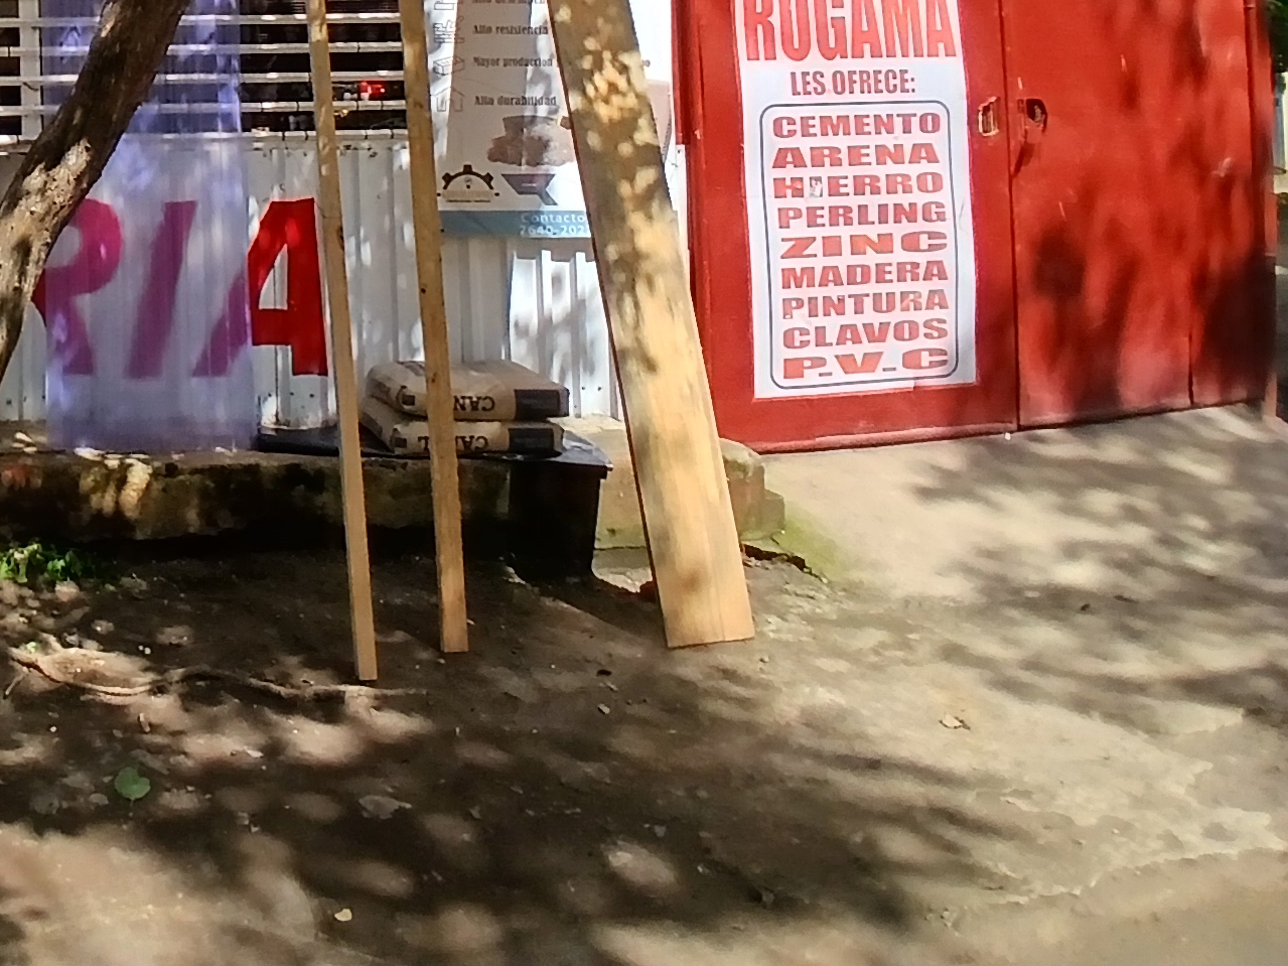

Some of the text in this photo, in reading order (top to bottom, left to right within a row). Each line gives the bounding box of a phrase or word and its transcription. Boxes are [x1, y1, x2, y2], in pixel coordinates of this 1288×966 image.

[790, 69, 915, 96] LES OFRECE:
[773, 112, 941, 139] CEMENTO
[772, 142, 940, 169] ARENA
[773, 172, 944, 199] HIERRO
[778, 201, 948, 229] PERLING
[780, 231, 948, 259] ZINC
[781, 260, 949, 290] MADERA
[782, 289, 949, 320] PINTURA
[783, 318, 949, 350] CLAVOS
